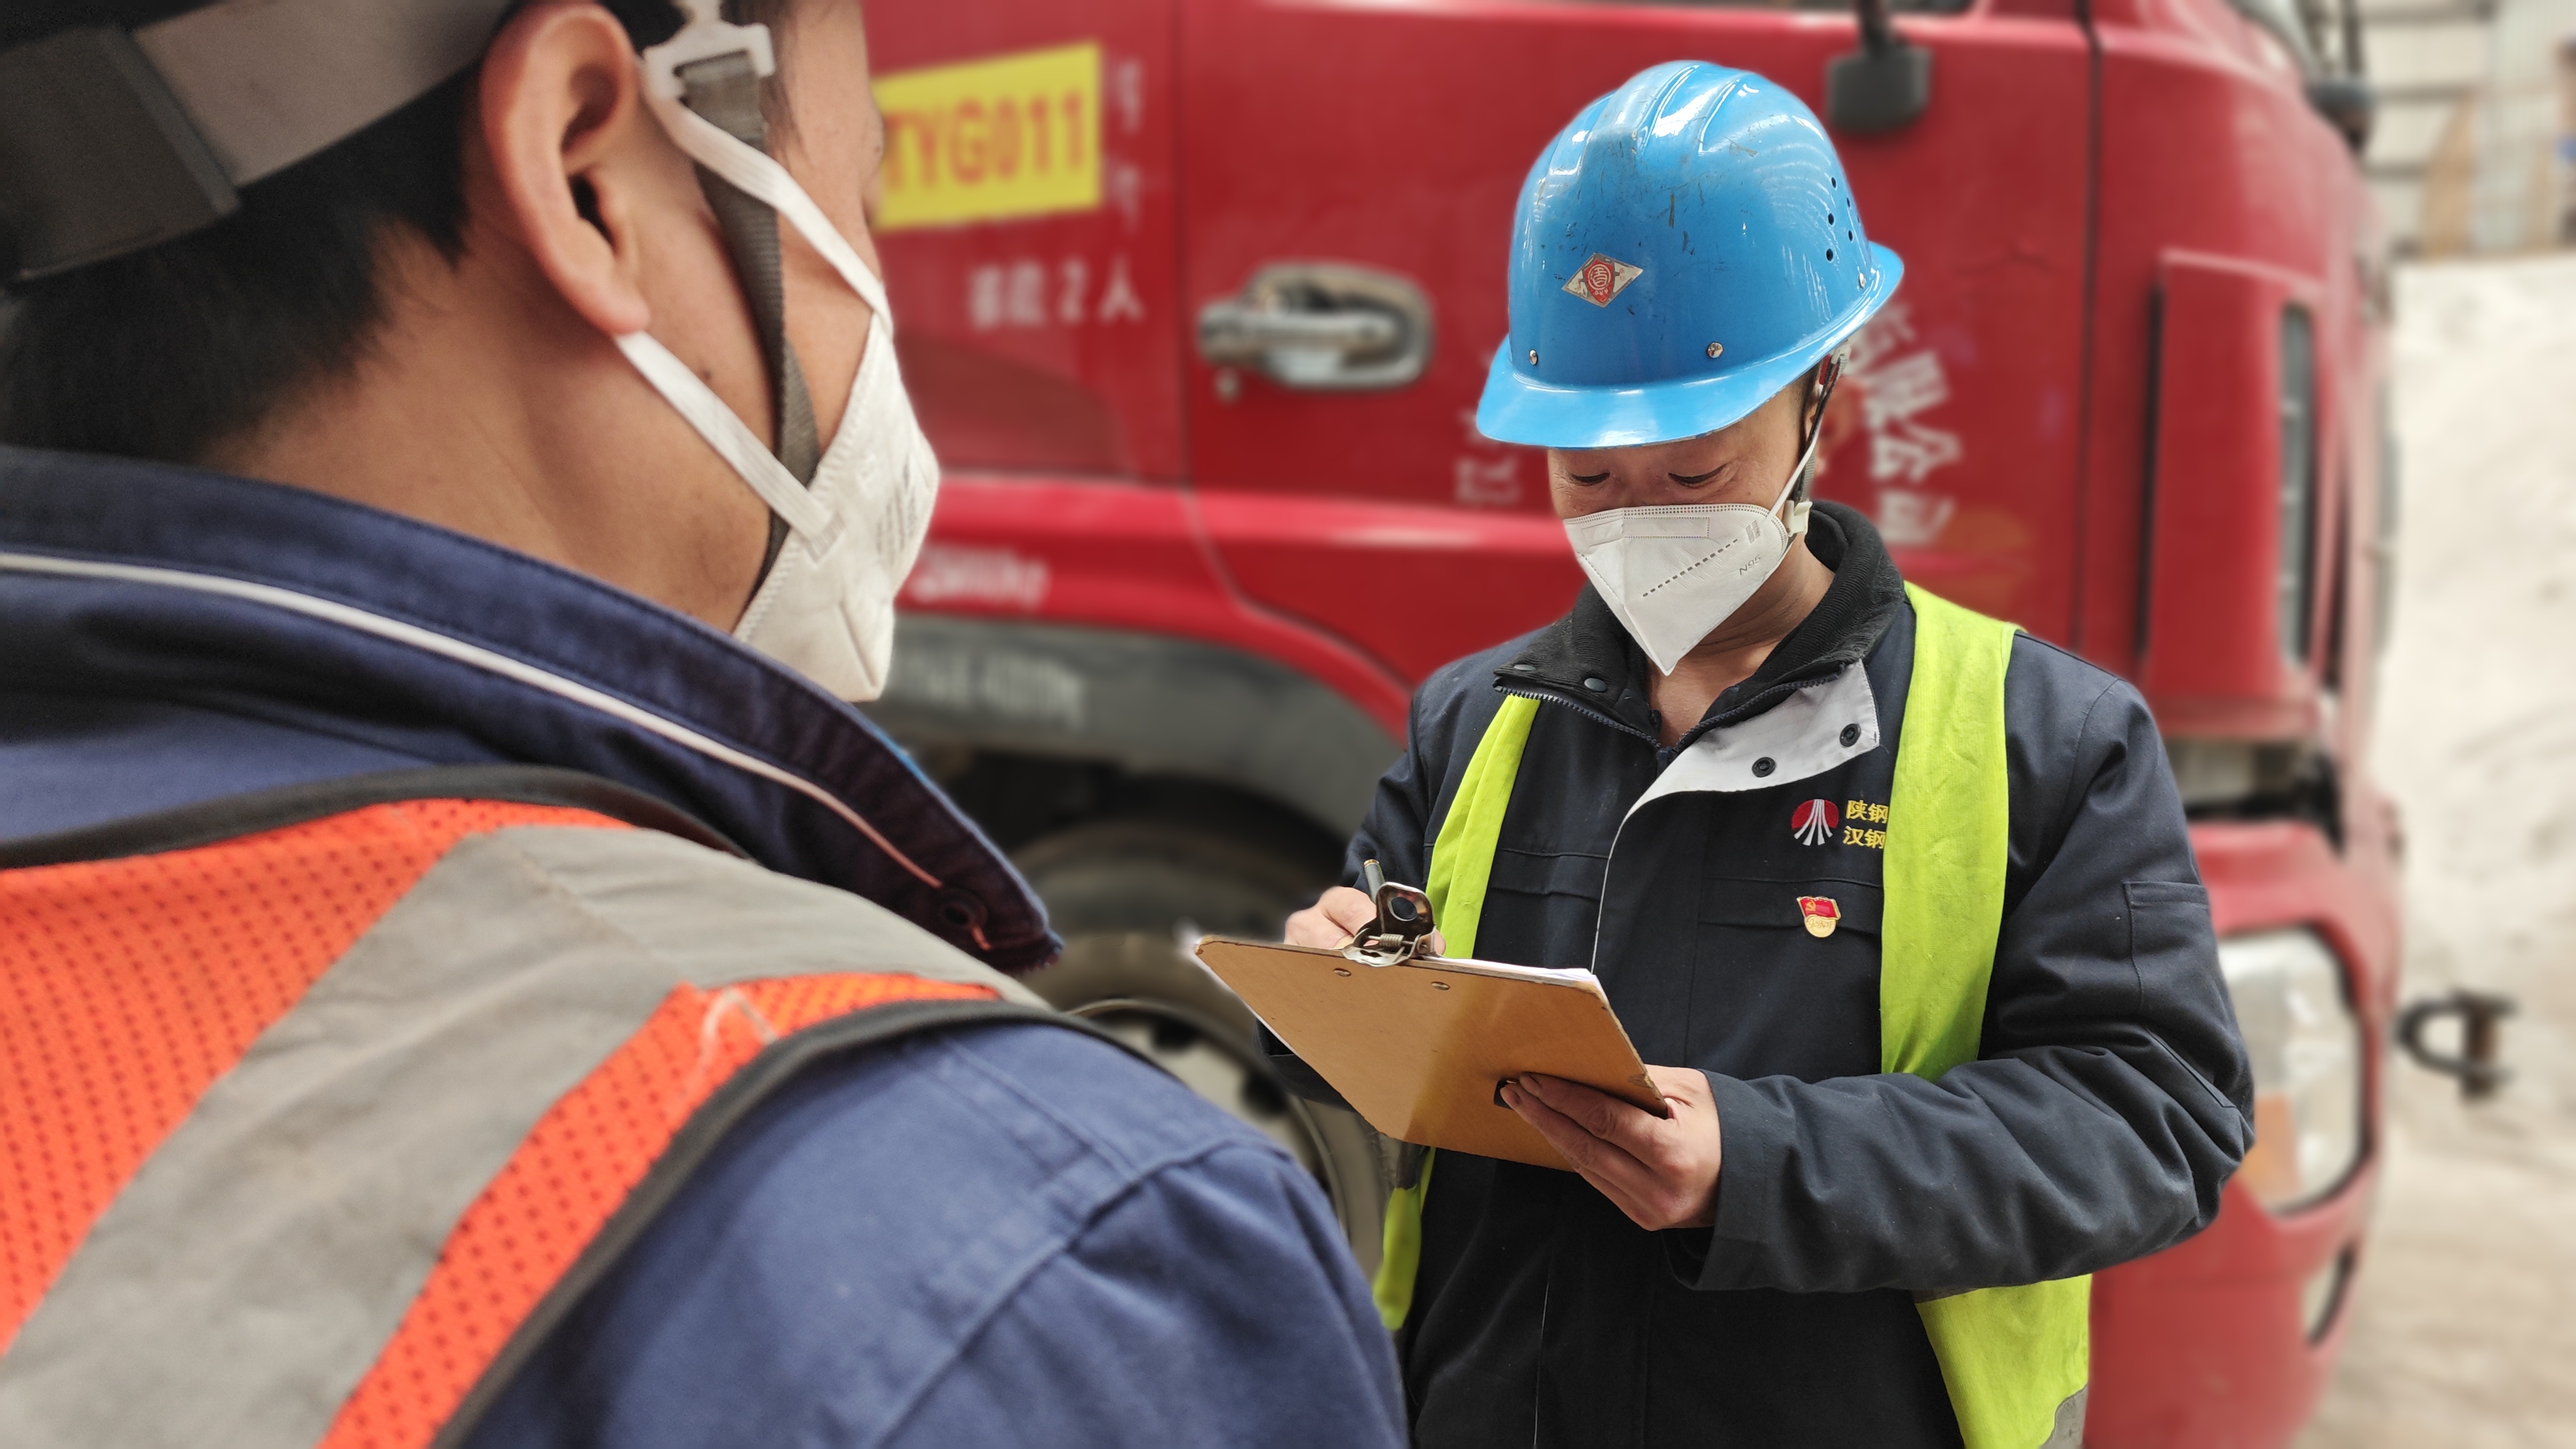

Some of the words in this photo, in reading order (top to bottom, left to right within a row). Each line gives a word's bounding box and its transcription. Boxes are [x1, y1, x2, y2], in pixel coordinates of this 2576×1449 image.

[1740, 555, 1761, 575] N95
[1846, 800, 1889, 823] 陕钢
[1843, 826, 1886, 848] 汉钢
